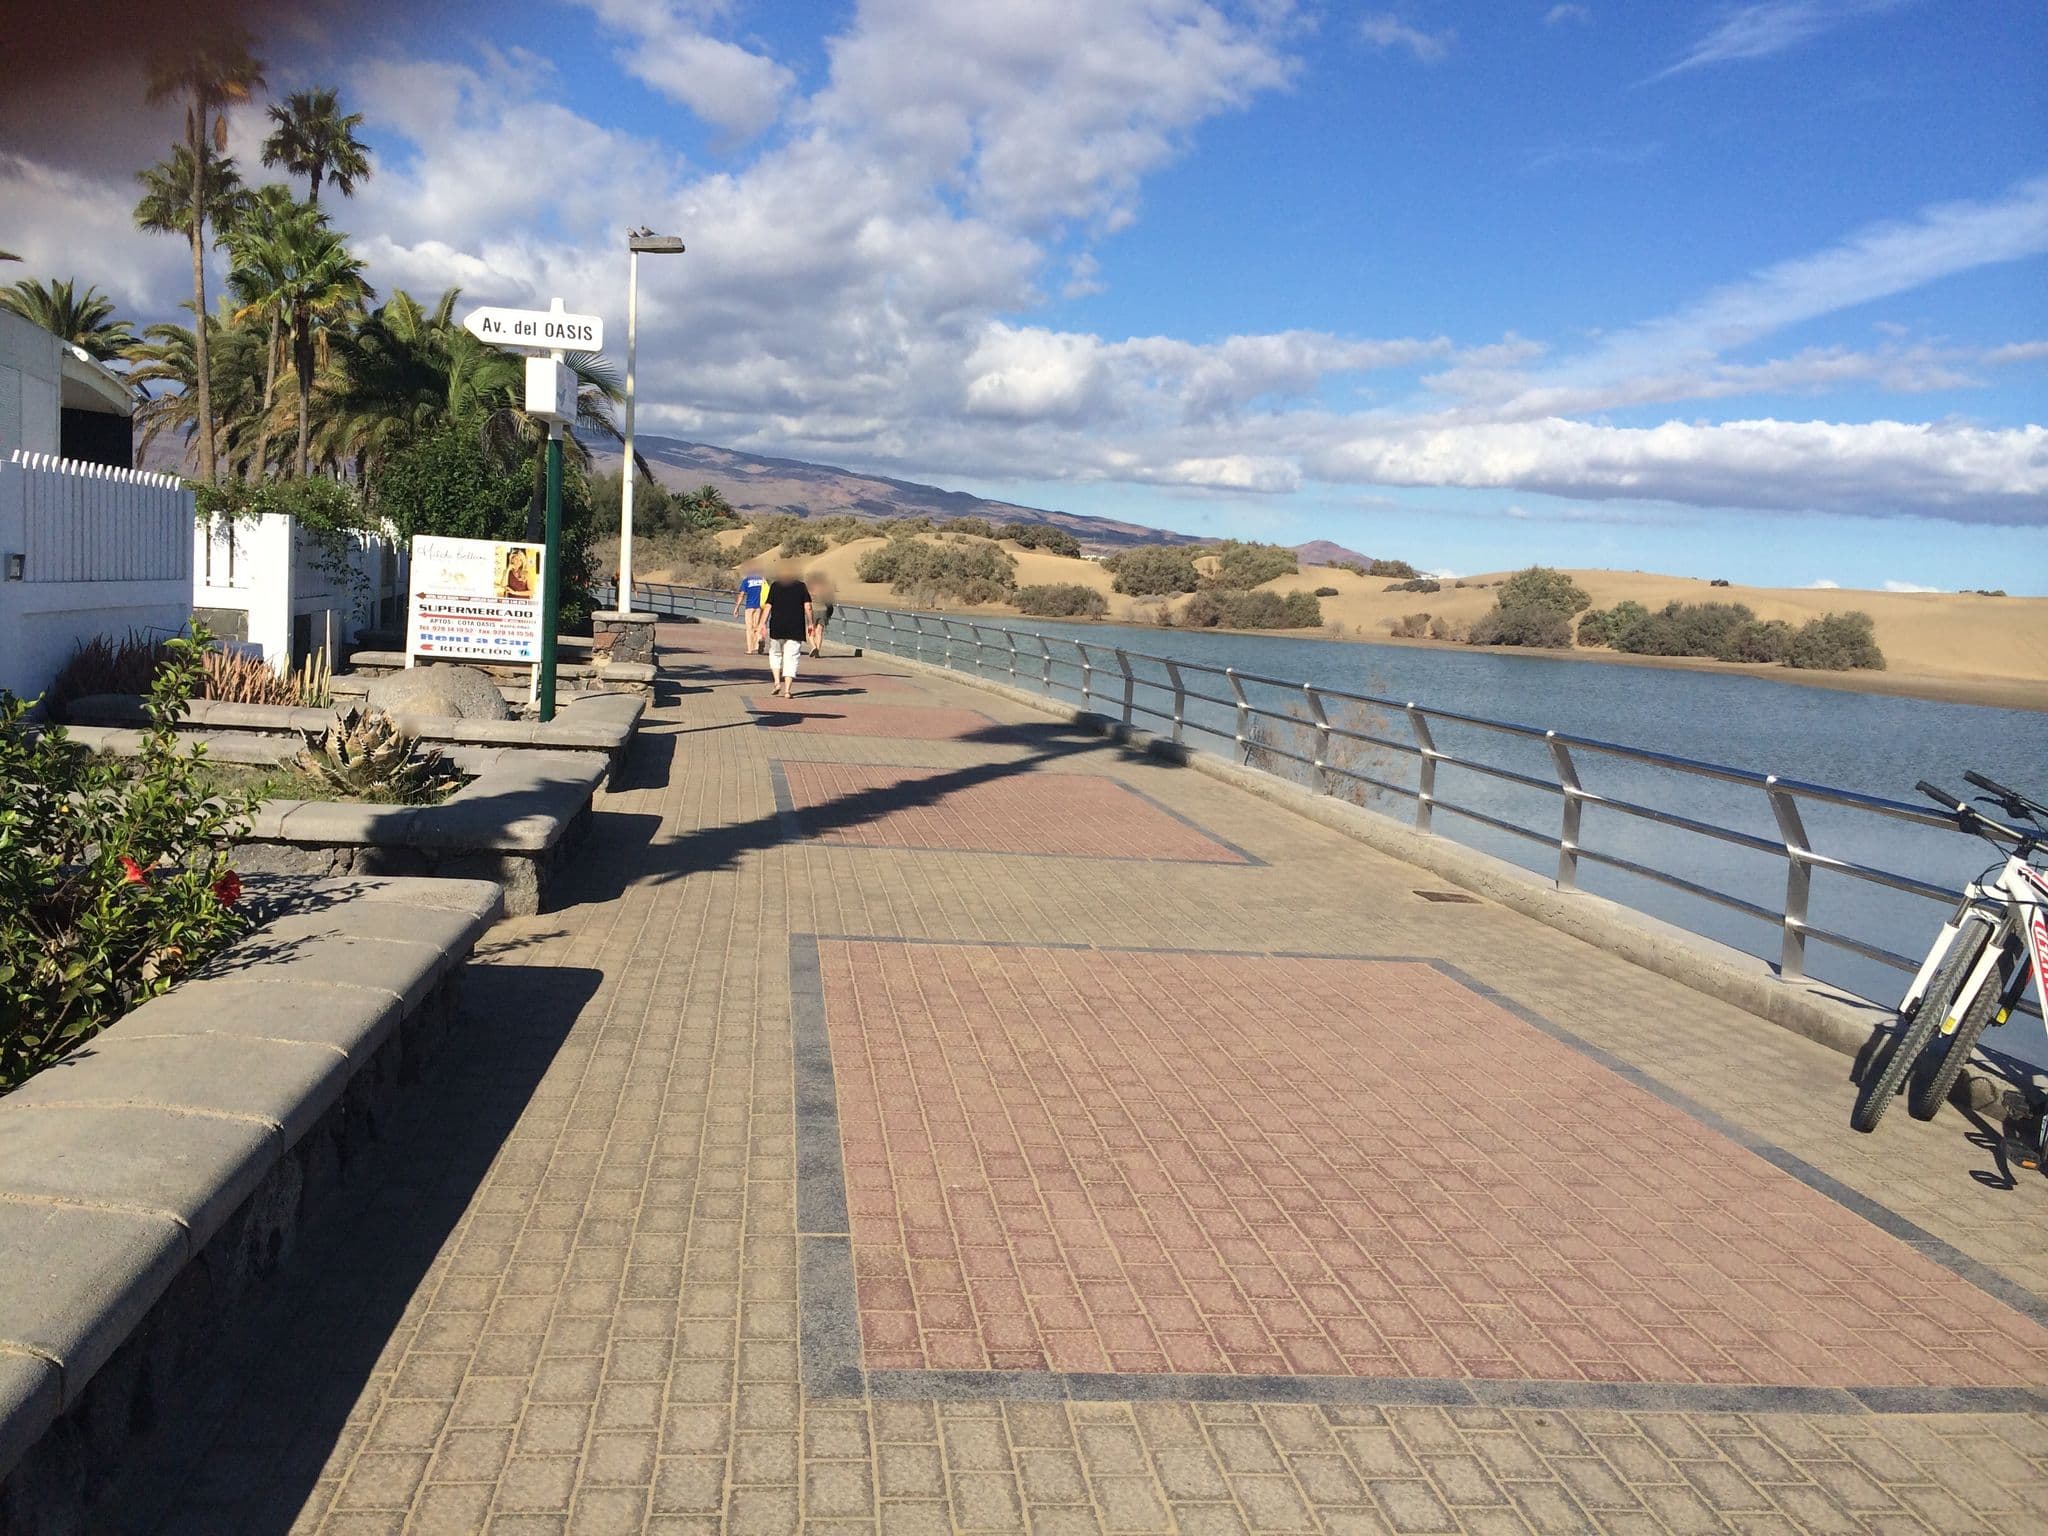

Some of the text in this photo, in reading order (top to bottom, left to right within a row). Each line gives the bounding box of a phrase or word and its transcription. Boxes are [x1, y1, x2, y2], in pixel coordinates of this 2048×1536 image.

[482, 317, 593, 341] Av. del OASIS
[419, 604, 533, 618] SUPERMERCADO
[420, 633, 470, 643] Rent
[494, 637, 532, 647] Car
[440, 644, 512, 656] RECEPCIÓN
